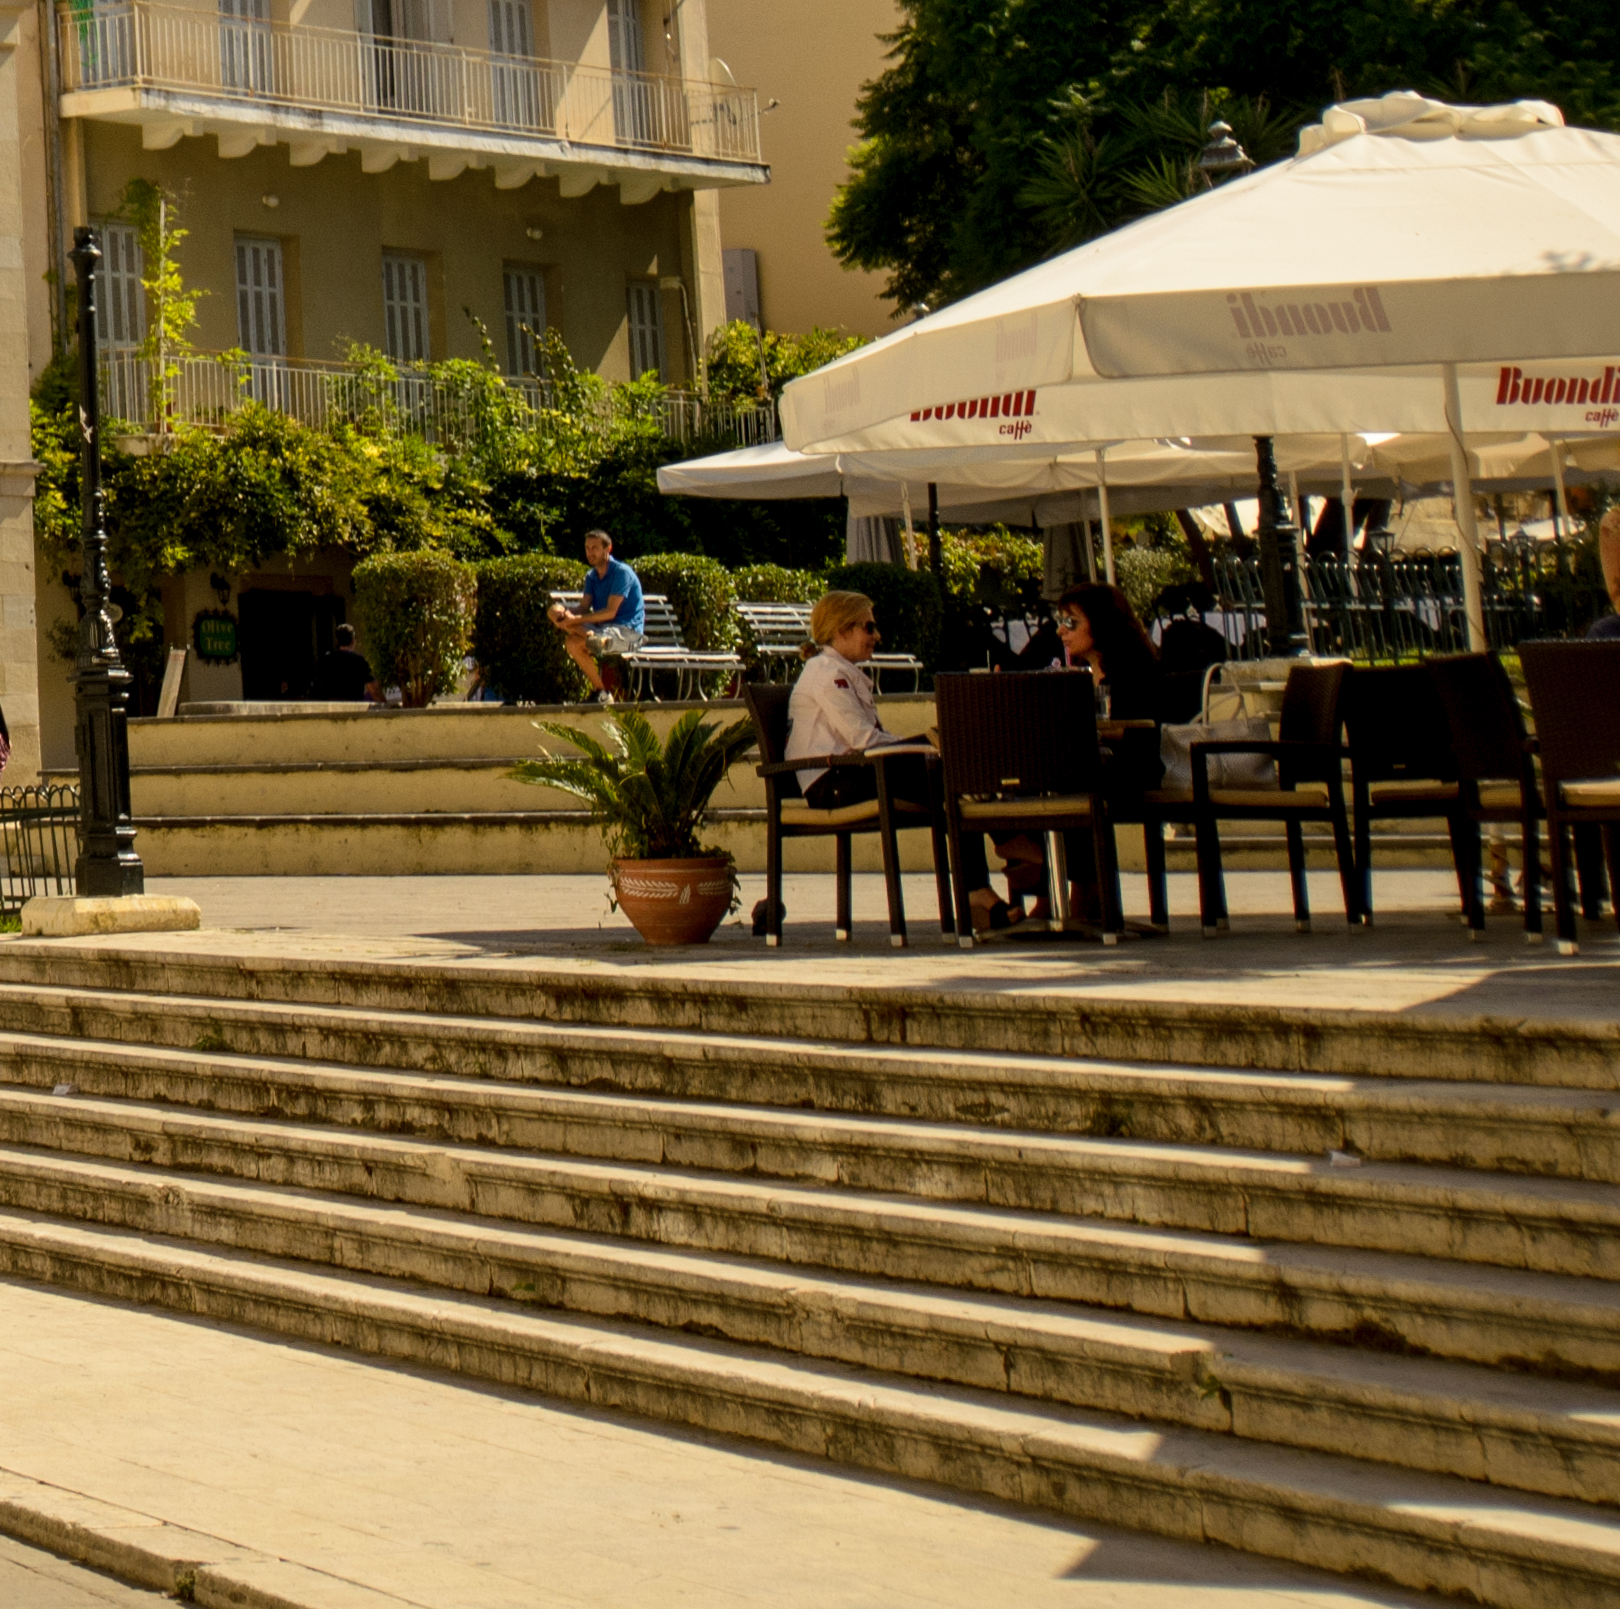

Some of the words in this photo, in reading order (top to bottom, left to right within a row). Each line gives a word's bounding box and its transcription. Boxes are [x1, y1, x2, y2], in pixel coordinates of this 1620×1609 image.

[910, 390, 1036, 422] uondi
[1585, 408, 1620, 428] caffè
[999, 420, 1032, 440] caffè
[201, 620, 234, 633] Olive
[204, 637, 231, 651] Tree
